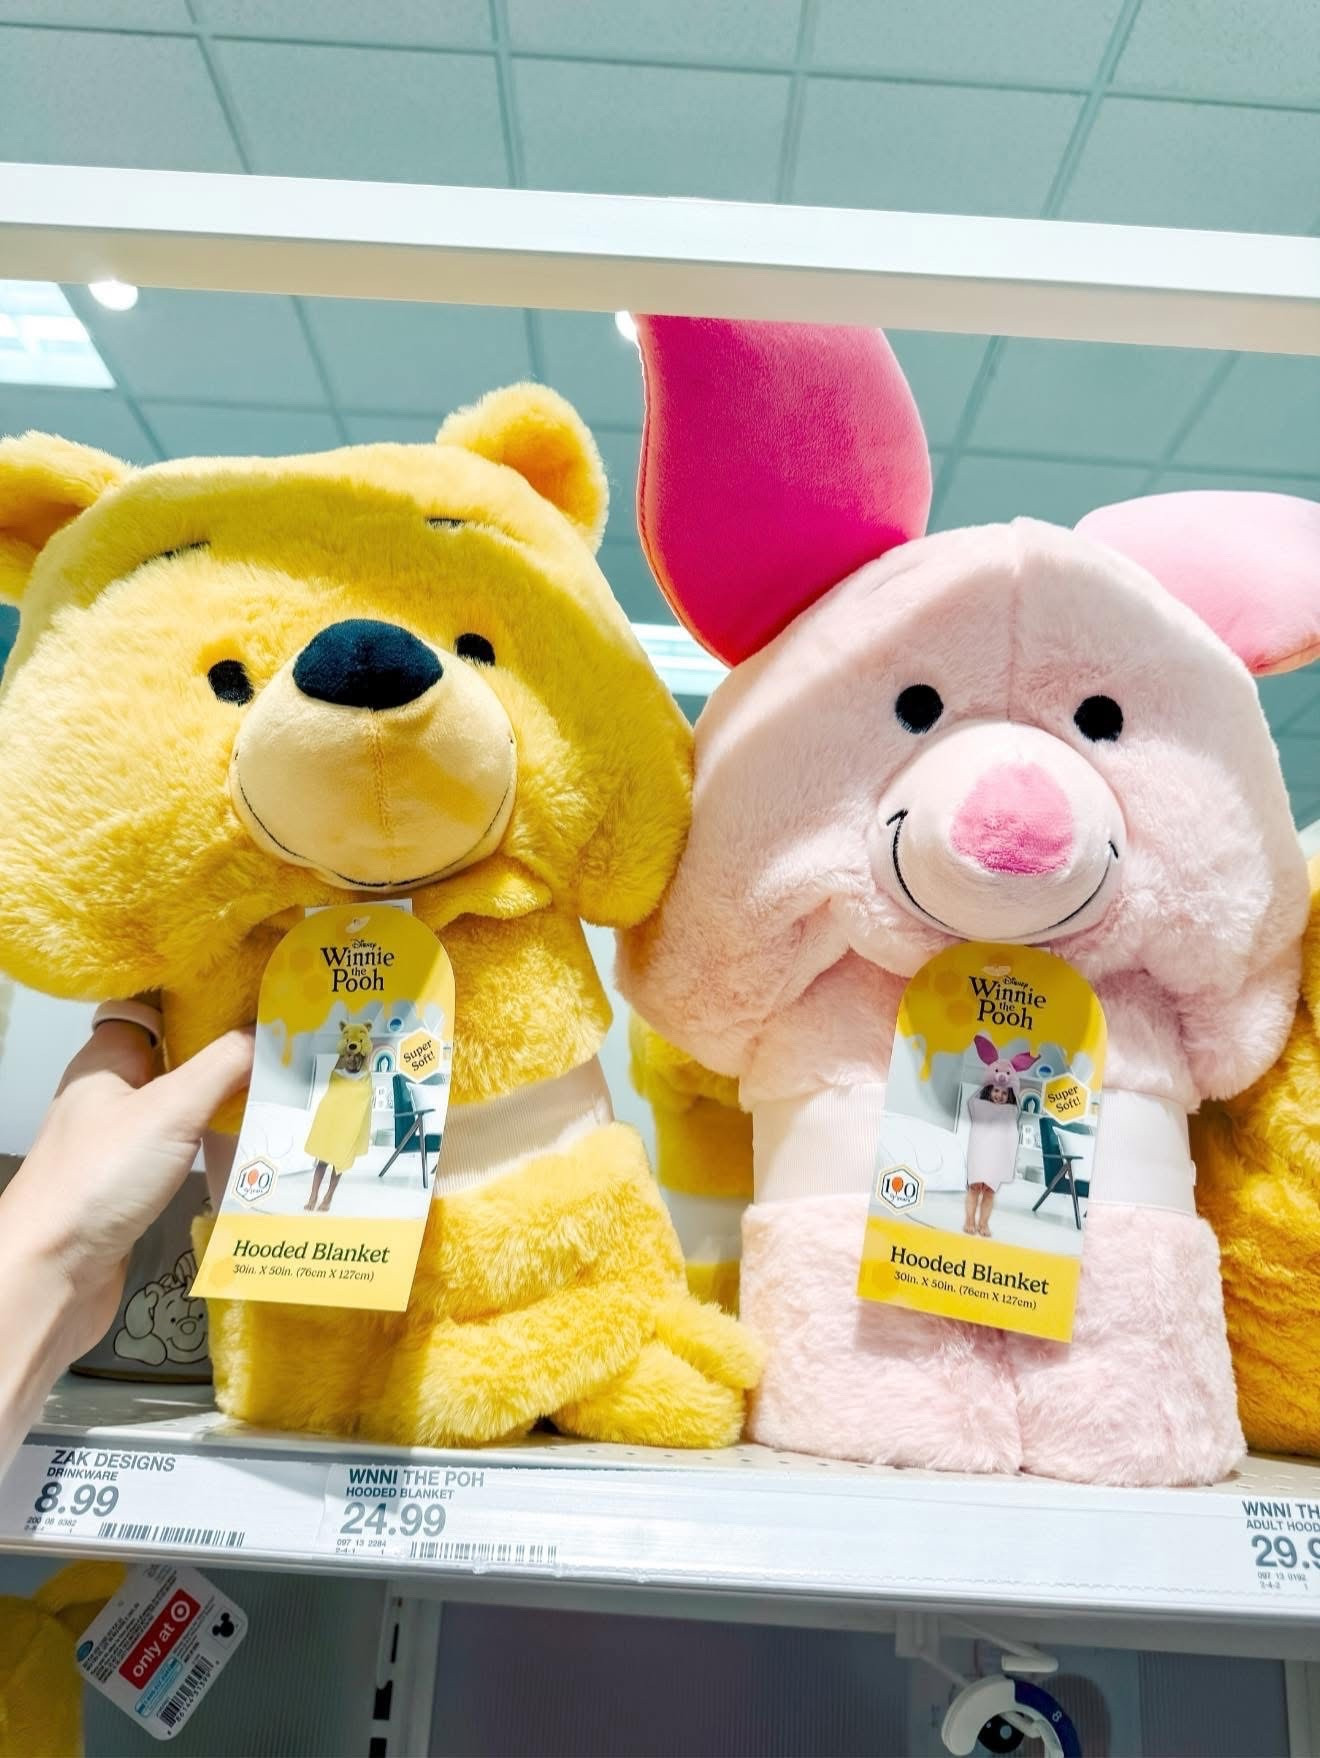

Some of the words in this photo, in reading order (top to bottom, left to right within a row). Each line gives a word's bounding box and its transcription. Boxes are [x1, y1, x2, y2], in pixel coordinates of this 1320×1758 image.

[352, 939, 377, 951] Disney
[320, 946, 395, 967] Winnie
[331, 968, 385, 992] Pooh
[351, 967, 367, 977] the
[968, 976, 1047, 1009] Winnie
[1003, 976, 1029, 989] Disney
[977, 999, 1034, 1030] Pooh
[999, 1001, 1015, 1012] the
[403, 1039, 432, 1063] Super
[411, 1050, 436, 1072] Soft!
[1047, 1085, 1078, 1104] Super
[1056, 1096, 1081, 1113] Soft!
[232, 1239, 309, 1259] Hooded
[312, 1242, 390, 1264] Blanket
[232, 1264, 257, 1274] 30in.
[259, 1265, 268, 1274] X
[269, 1267, 294, 1277] 50in.
[296, 1267, 327, 1278] (76cm
[329, 1270, 337, 1279] X
[339, 1270, 375, 1282] 127cm)
[890, 1245, 966, 1278] Hooded
[972, 1263, 1050, 1295] Blanket
[893, 1270, 919, 1285] 30in.
[921, 1277, 929, 1287] X
[930, 1280, 957, 1293] 50in.
[959, 1285, 989, 1300] (76cm
[991, 1293, 1000, 1303] X
[1002, 1294, 1037, 1311] 127cm)
[51, 1450, 92, 1466] ZAK
[94, 1453, 176, 1472] DESIGNS
[47, 1467, 119, 1481] DRINKWARE
[349, 1468, 398, 1485] WNNI
[404, 1470, 439, 1486] THE
[445, 1471, 485, 1487] POH
[35, 1481, 119, 1517] 8.99
[346, 1487, 396, 1498] HOODED
[400, 1488, 455, 1499] BLANKET
[340, 1501, 446, 1537] 24.99
[1241, 1500, 1291, 1518] WNNI
[1246, 1519, 1283, 1531] ADULT
[336, 1538, 351, 1546] 097
[132, 1640, 161, 1677] only
[159, 1622, 175, 1642] at
